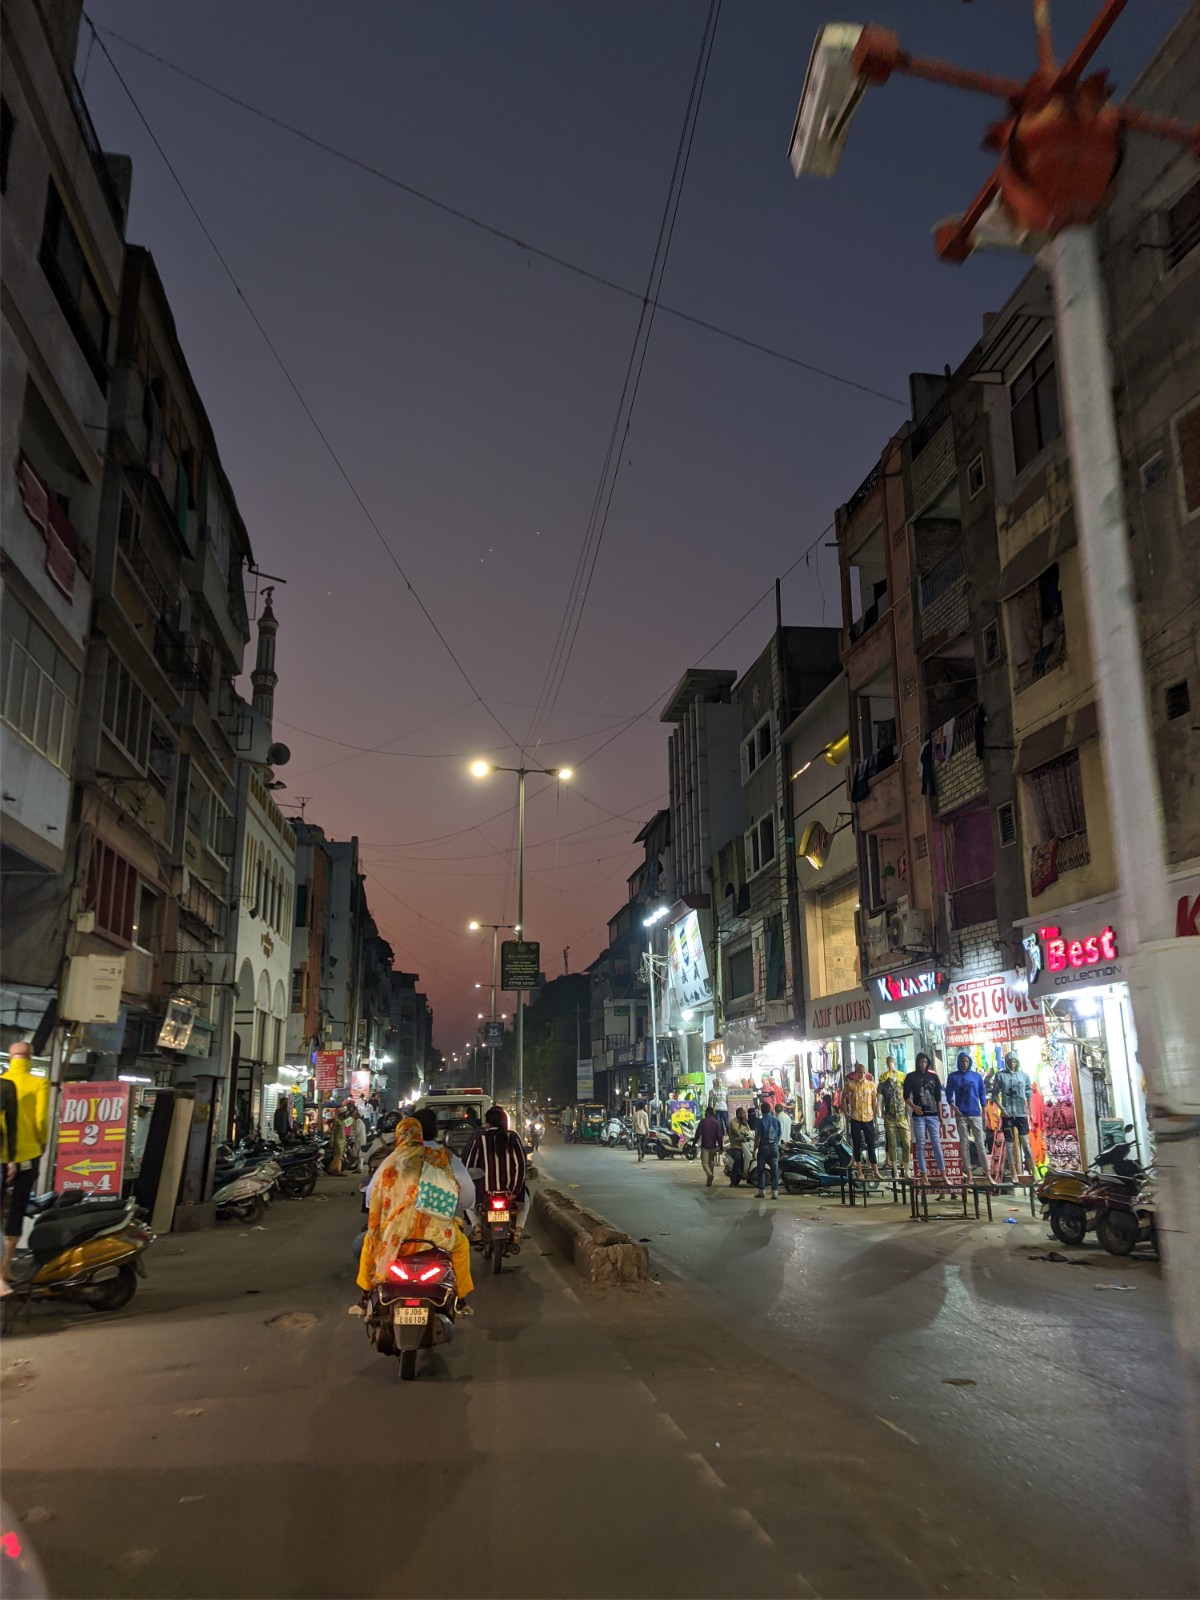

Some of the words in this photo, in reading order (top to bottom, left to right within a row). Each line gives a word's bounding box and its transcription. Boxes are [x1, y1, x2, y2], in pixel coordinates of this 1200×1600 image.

[1046, 926, 1116, 972] Best
[812, 1007, 832, 1029] ASIF
[834, 998, 871, 1026] CLOTHS
[63, 1097, 123, 1122] BOYOB
[82, 1125, 98, 1145] 2
[63, 1180, 82, 1190] Shop
[97, 1174, 112, 1190] 4
[404, 1308, 423, 1316] GJ06
